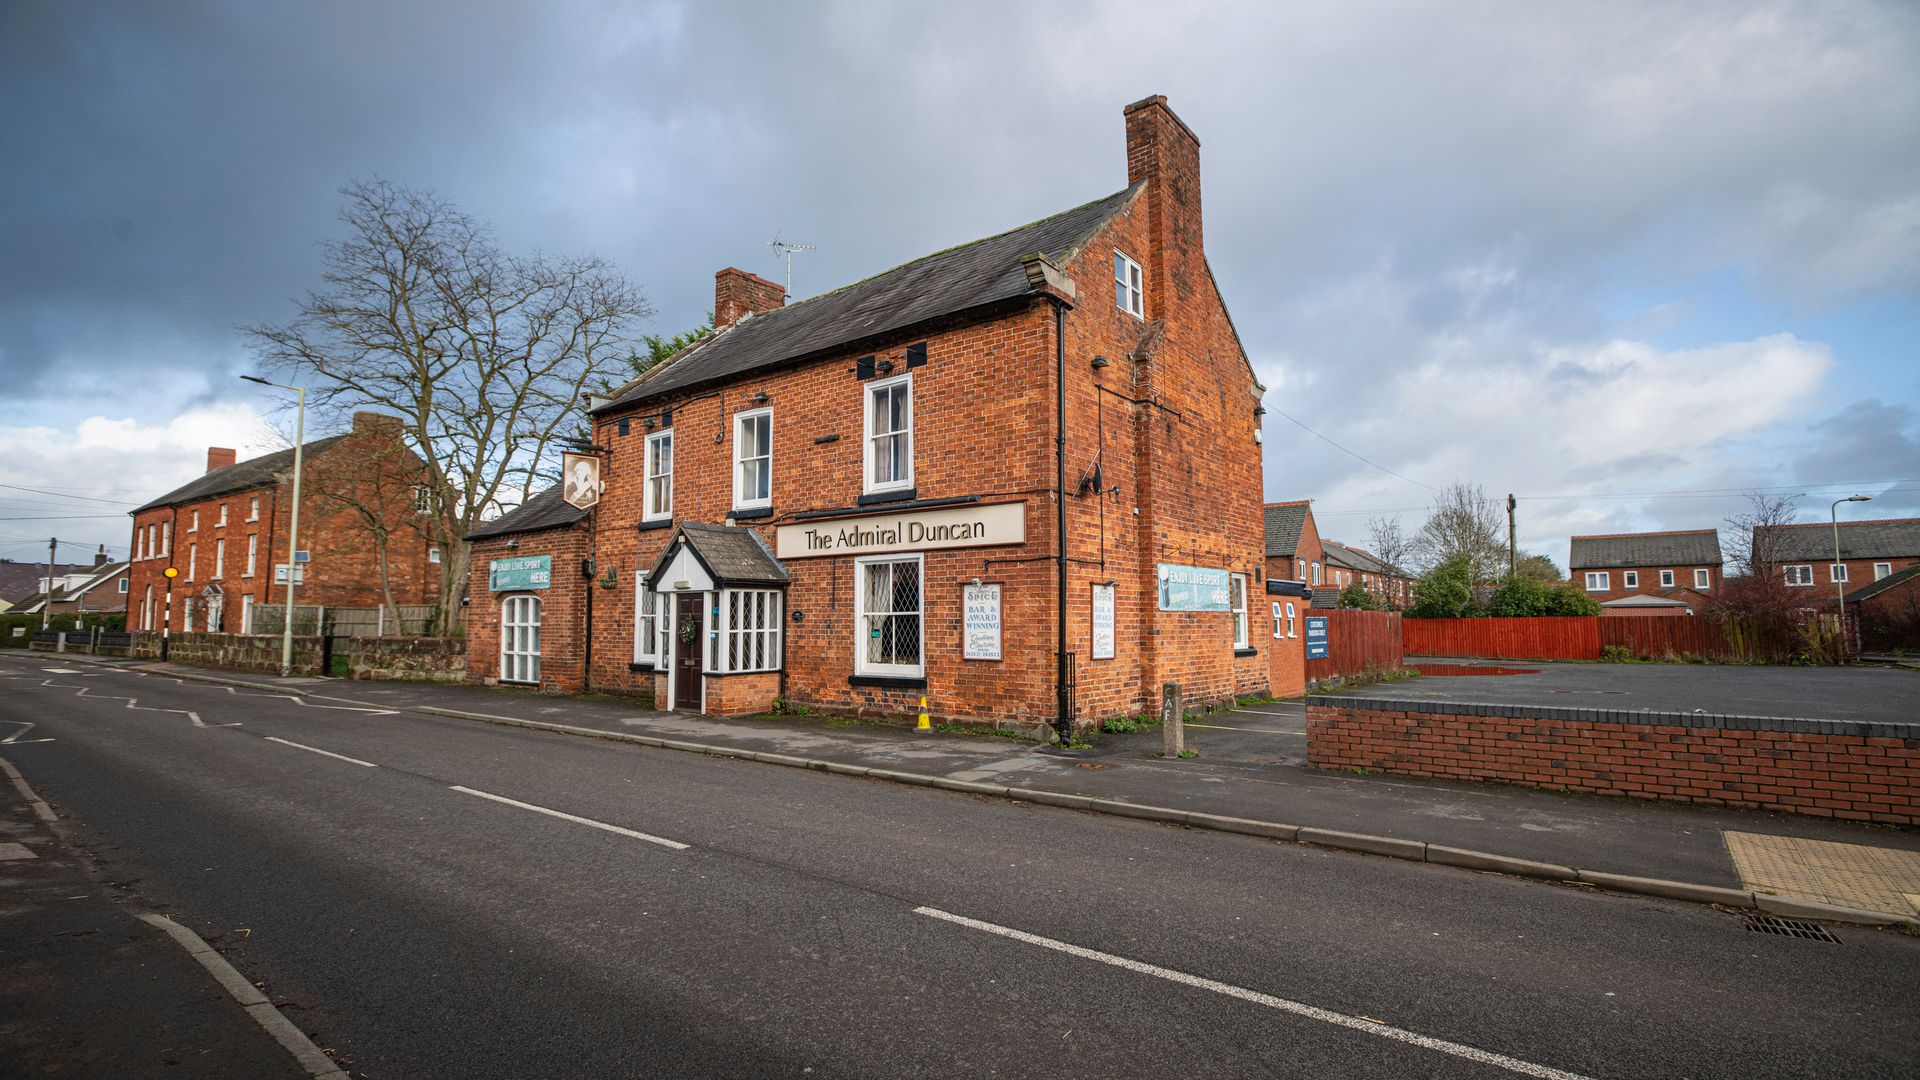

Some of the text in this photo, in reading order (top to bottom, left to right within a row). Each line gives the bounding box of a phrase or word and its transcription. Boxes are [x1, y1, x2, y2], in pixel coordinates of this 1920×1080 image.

[804, 521, 985, 550] The Admiral Duncan
[497, 560, 541, 572] ENJOY LIVE SPORT
[530, 571, 548, 583] HERE
[1170, 571, 1220, 586] ENJOY LIVE SPORT
[1211, 590, 1228, 604] HERE
[968, 606, 986, 614] BAR
[967, 614, 997, 622] AWARD
[966, 622, 999, 630] WINNING
